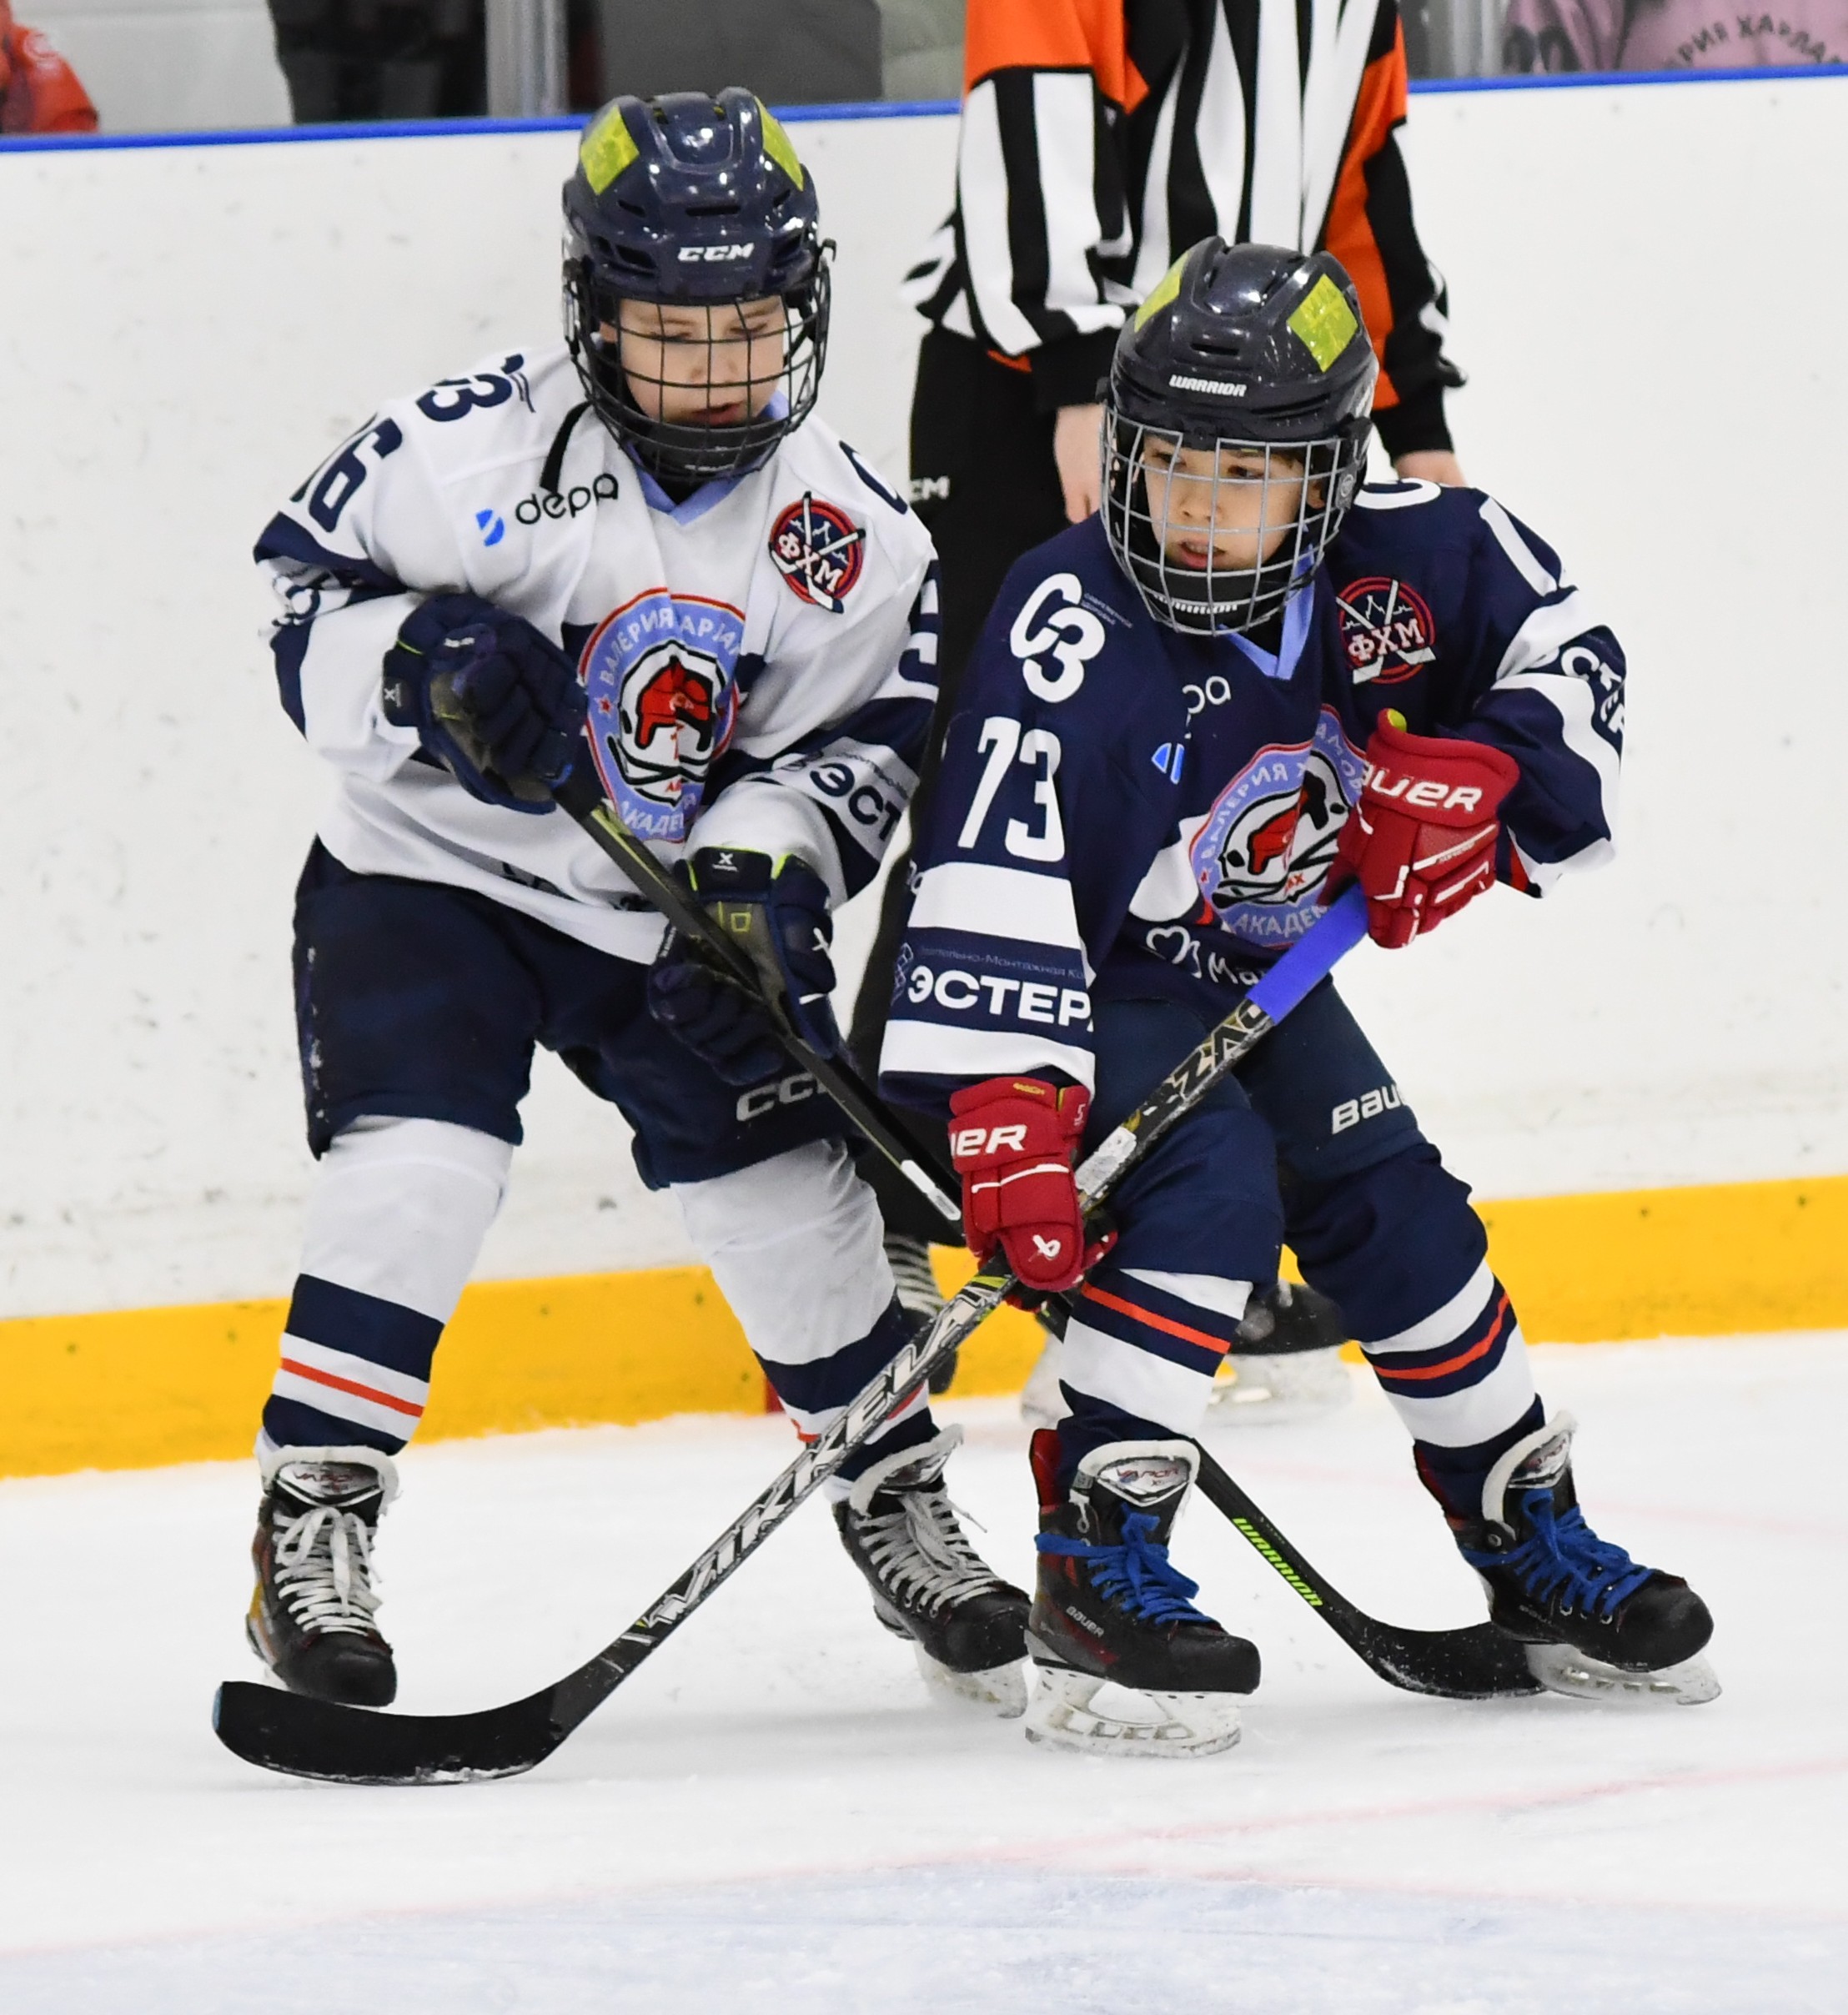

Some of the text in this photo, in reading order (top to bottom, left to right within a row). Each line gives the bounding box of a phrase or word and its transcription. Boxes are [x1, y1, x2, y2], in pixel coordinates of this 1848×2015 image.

[677, 242, 755, 262] CCM
[1168, 374, 1248, 397] WARRIOR
[777, 532, 844, 593] ФХМ
[1348, 617, 1424, 661] ФХМ
[957, 716, 1066, 862] 73
[907, 965, 1095, 1033] ЭСТЕР
[1233, 1516, 1323, 1608] WARRIOR
